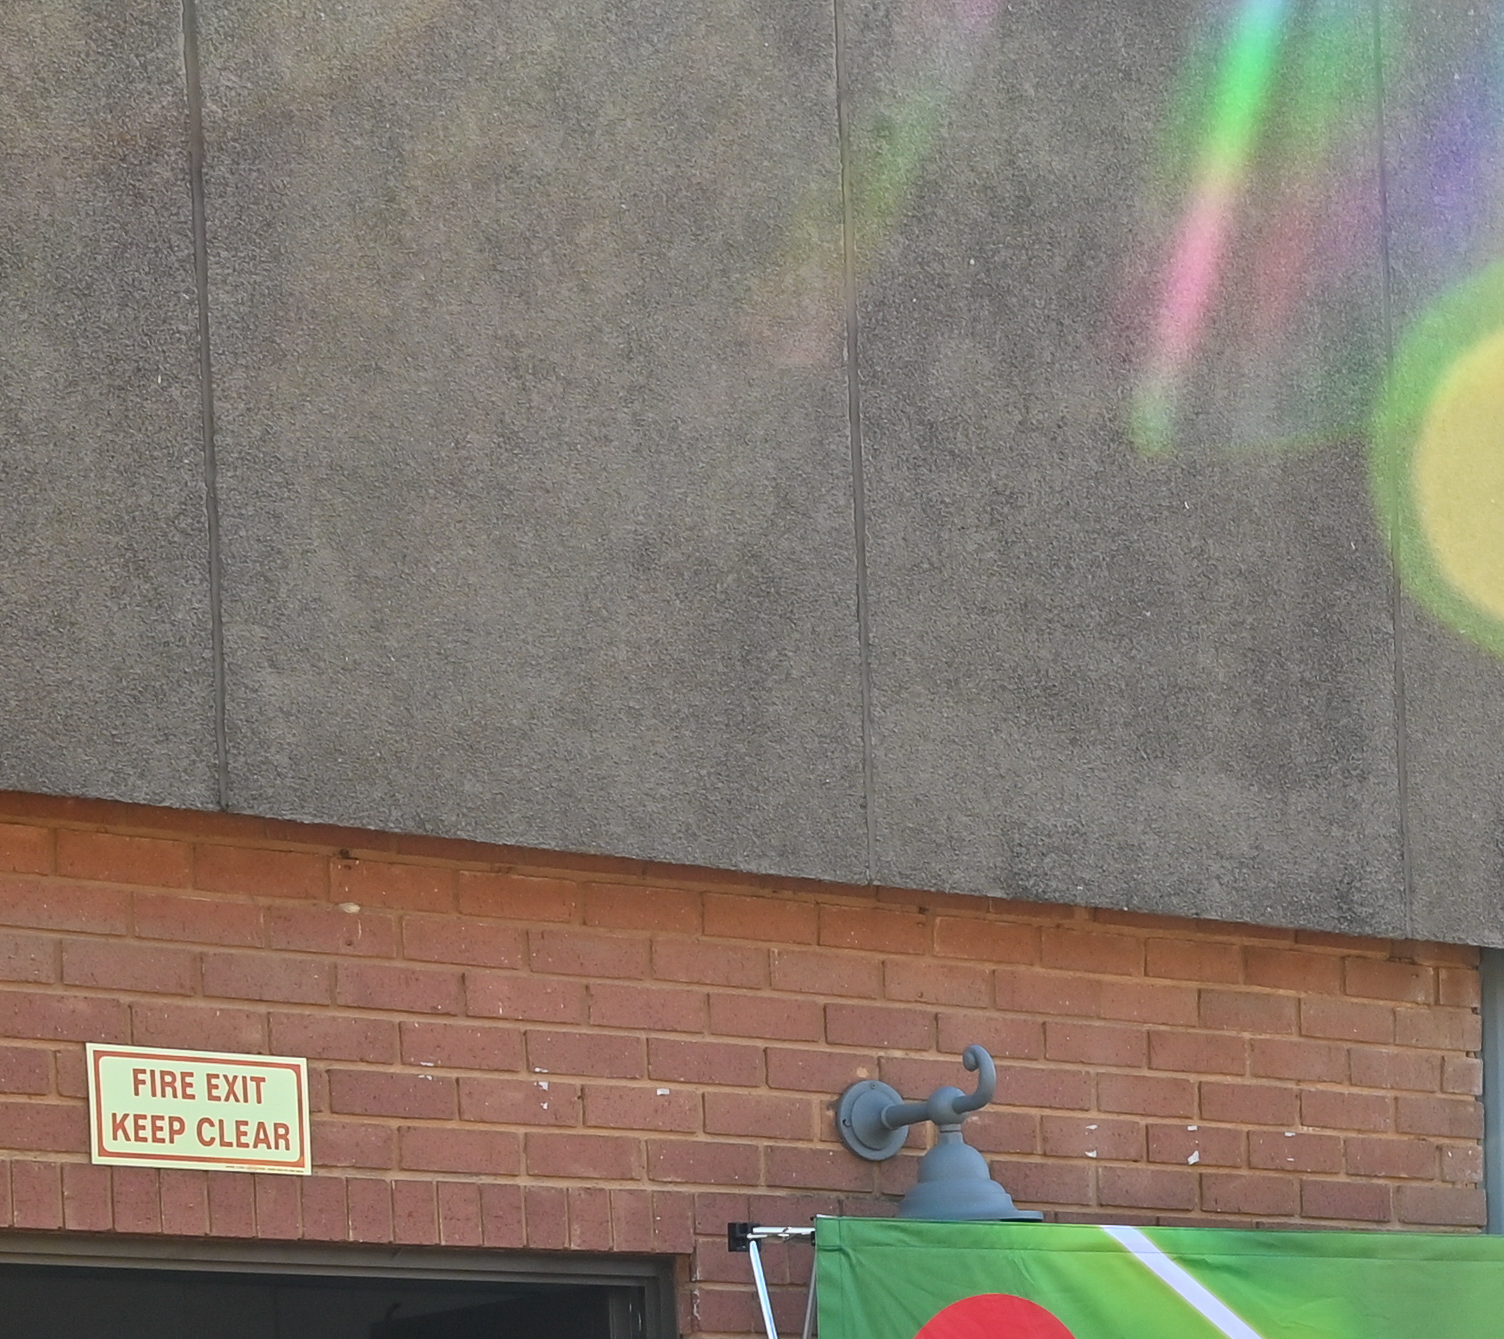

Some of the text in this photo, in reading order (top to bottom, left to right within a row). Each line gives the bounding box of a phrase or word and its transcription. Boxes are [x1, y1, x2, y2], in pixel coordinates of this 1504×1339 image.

[132, 1067, 266, 1105] FIRE EXIT
[112, 1112, 291, 1151] KEEP CLEAR
